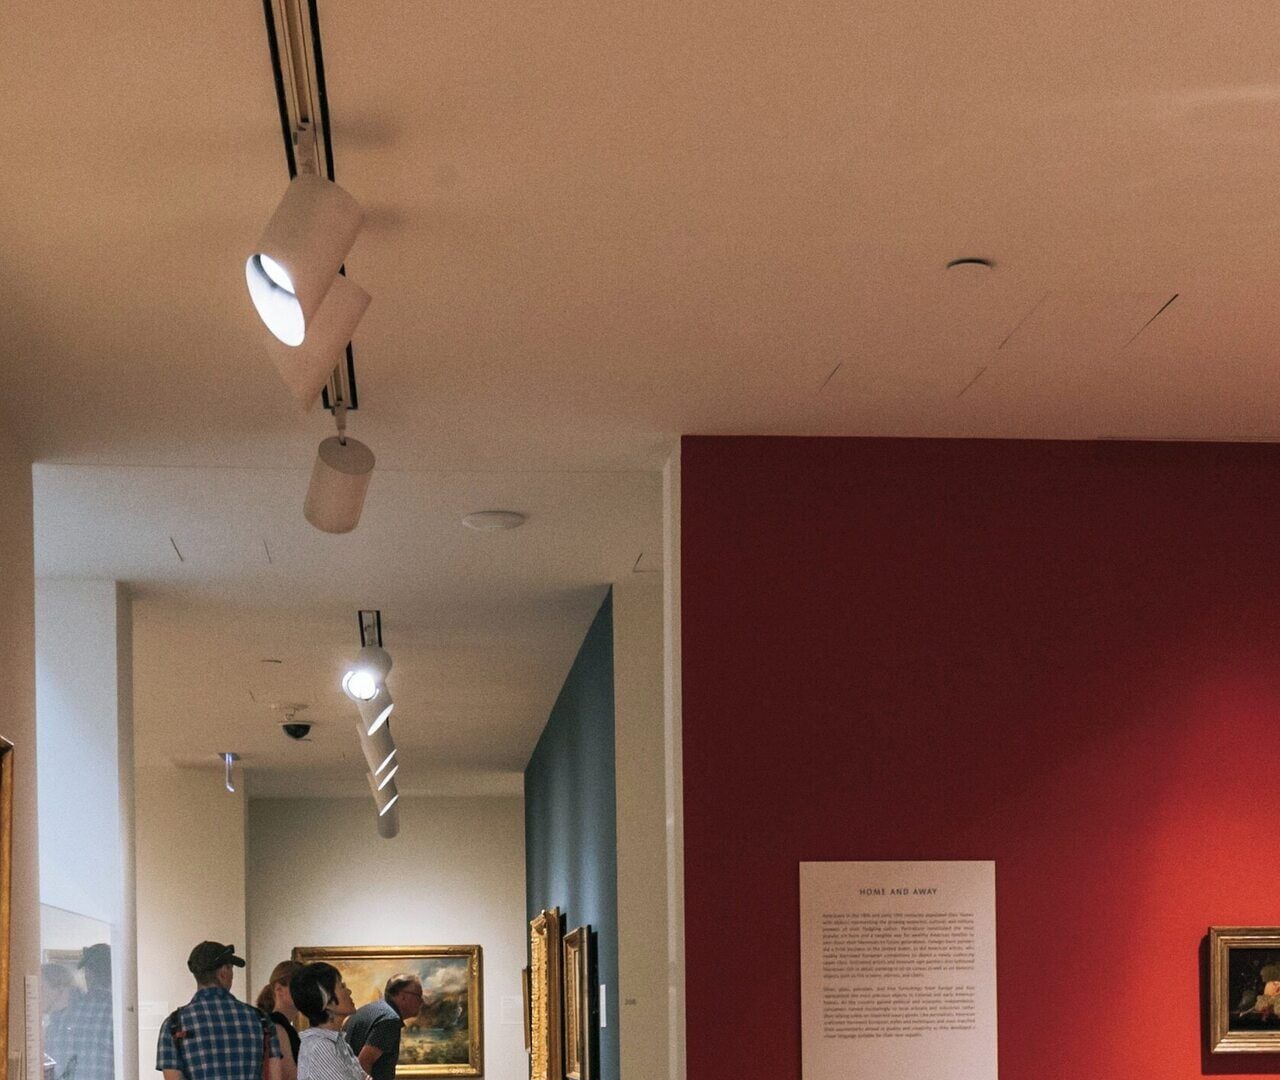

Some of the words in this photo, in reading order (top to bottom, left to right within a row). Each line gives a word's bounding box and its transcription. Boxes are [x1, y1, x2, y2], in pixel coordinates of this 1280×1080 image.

[859, 887, 886, 896] HOME
[890, 887, 910, 896] AND
[913, 887, 938, 896] AWAY
